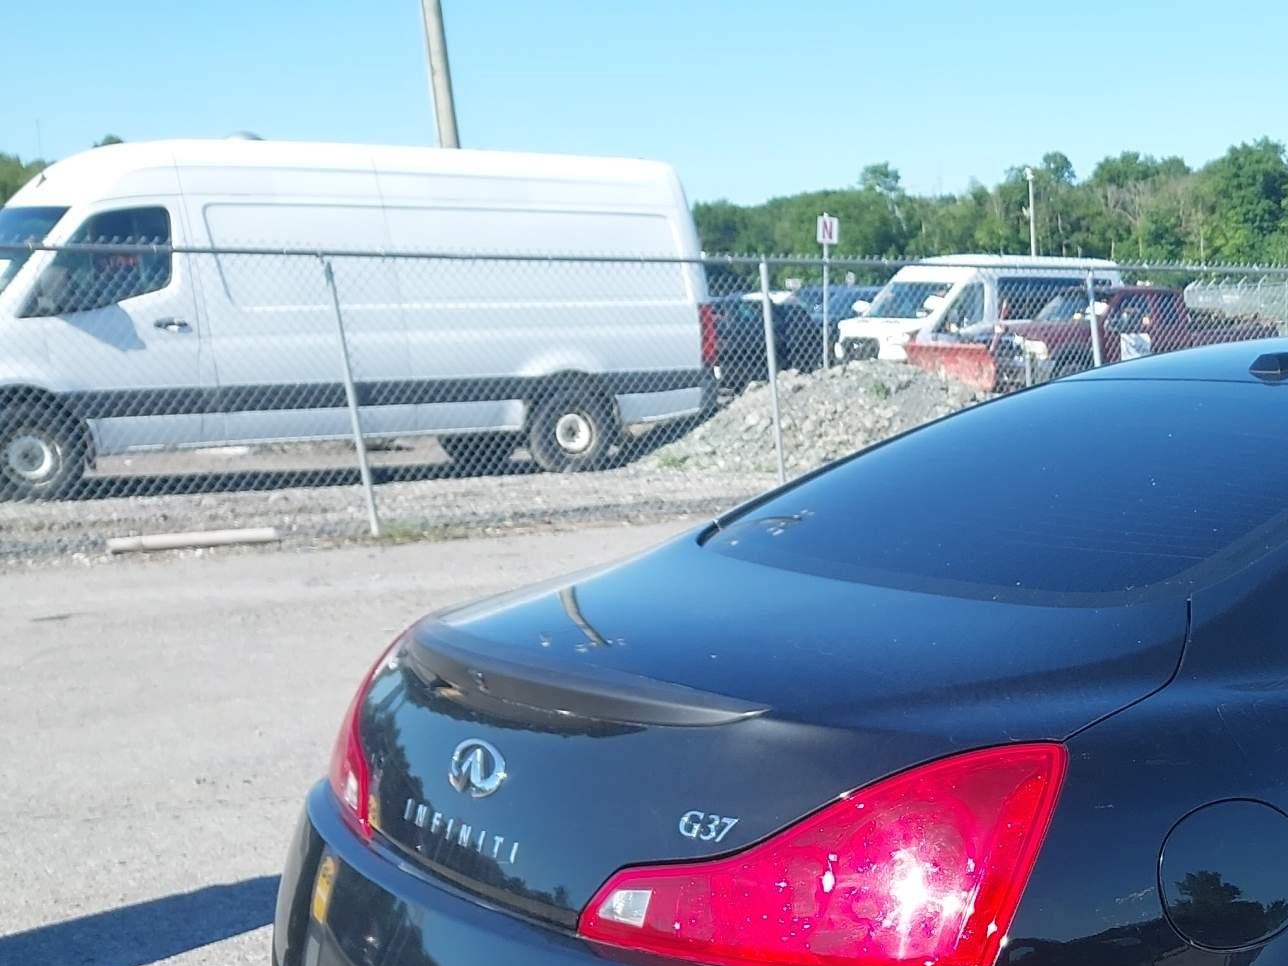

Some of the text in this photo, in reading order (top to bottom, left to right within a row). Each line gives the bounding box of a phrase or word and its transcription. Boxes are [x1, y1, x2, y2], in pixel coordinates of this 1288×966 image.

[822, 220, 833, 240] N
[403, 798, 519, 865] INFINITI
[679, 811, 739, 843] G37
